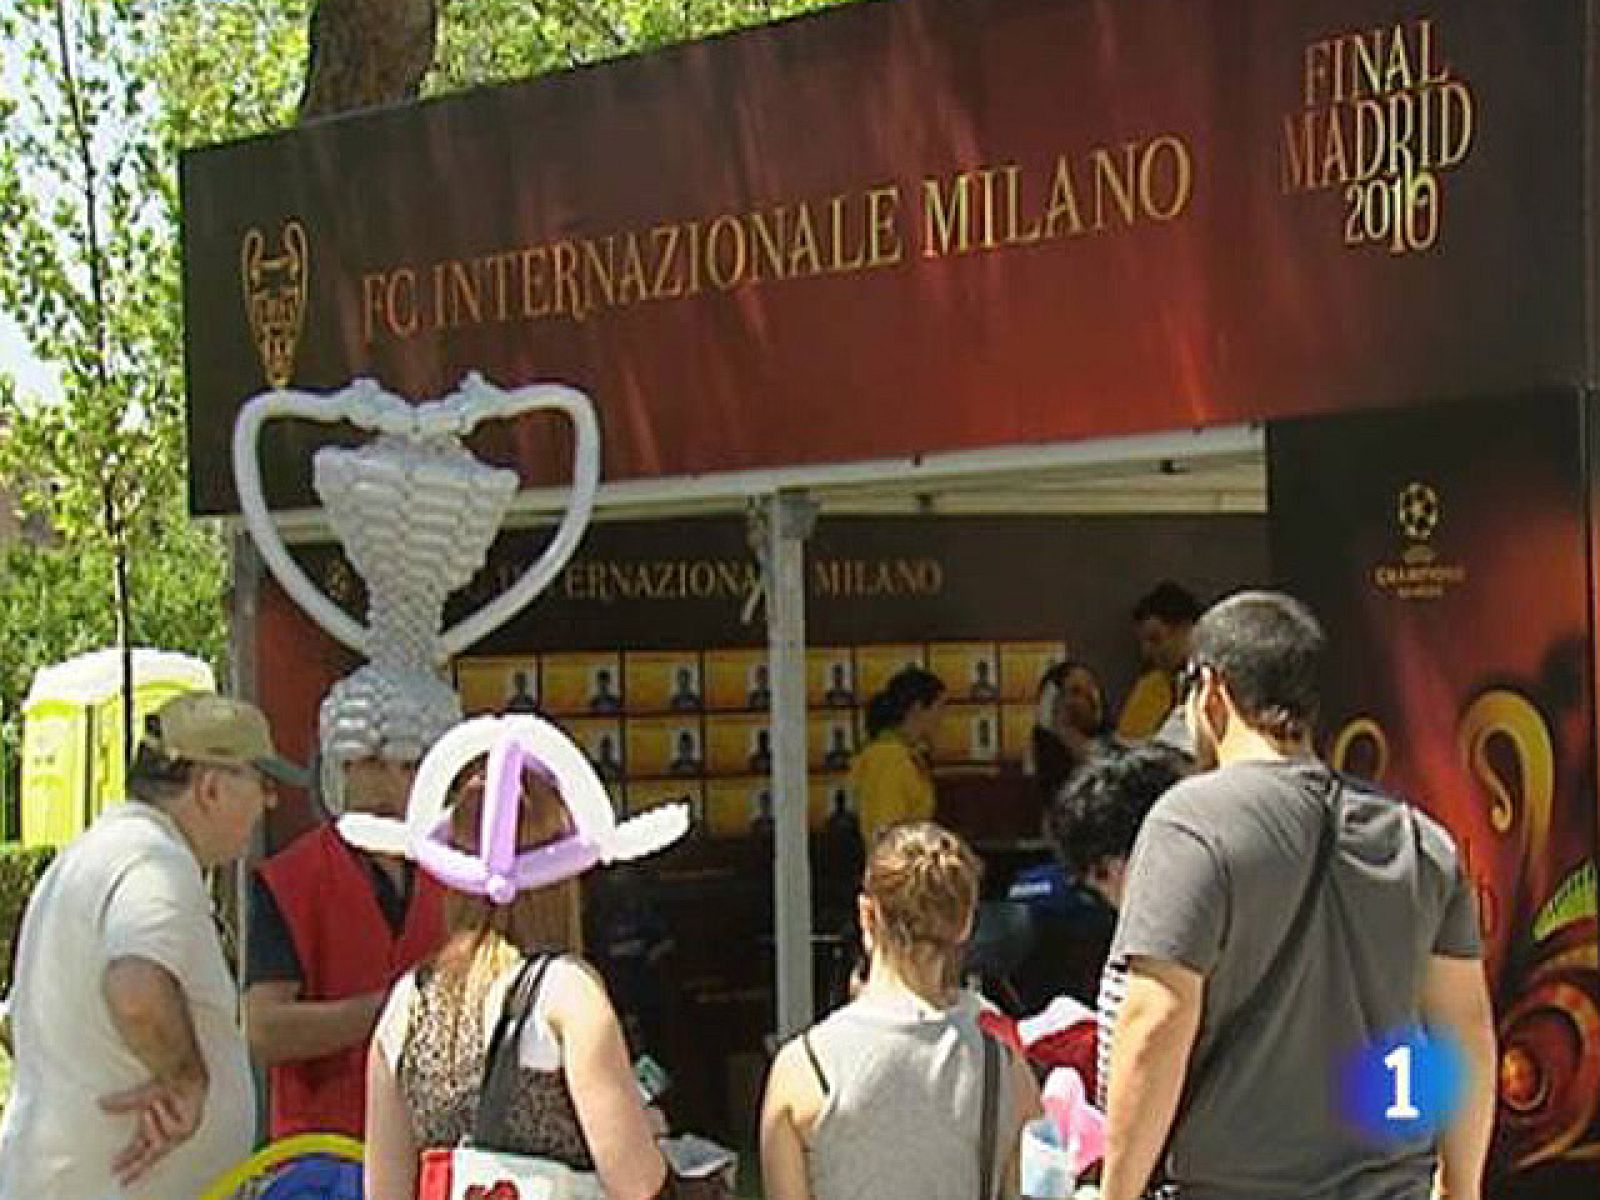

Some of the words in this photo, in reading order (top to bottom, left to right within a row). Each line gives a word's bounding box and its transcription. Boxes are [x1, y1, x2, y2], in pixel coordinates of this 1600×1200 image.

[1304, 19, 1449, 105] FINAL
[1281, 81, 1472, 194] MADRID
[362, 268, 418, 342] FC
[433, 186, 902, 325] INTERNAZIONALE
[922, 134, 1193, 259] MILANO
[1344, 173, 1439, 252] 2010
[814, 558, 944, 599] MILANO
